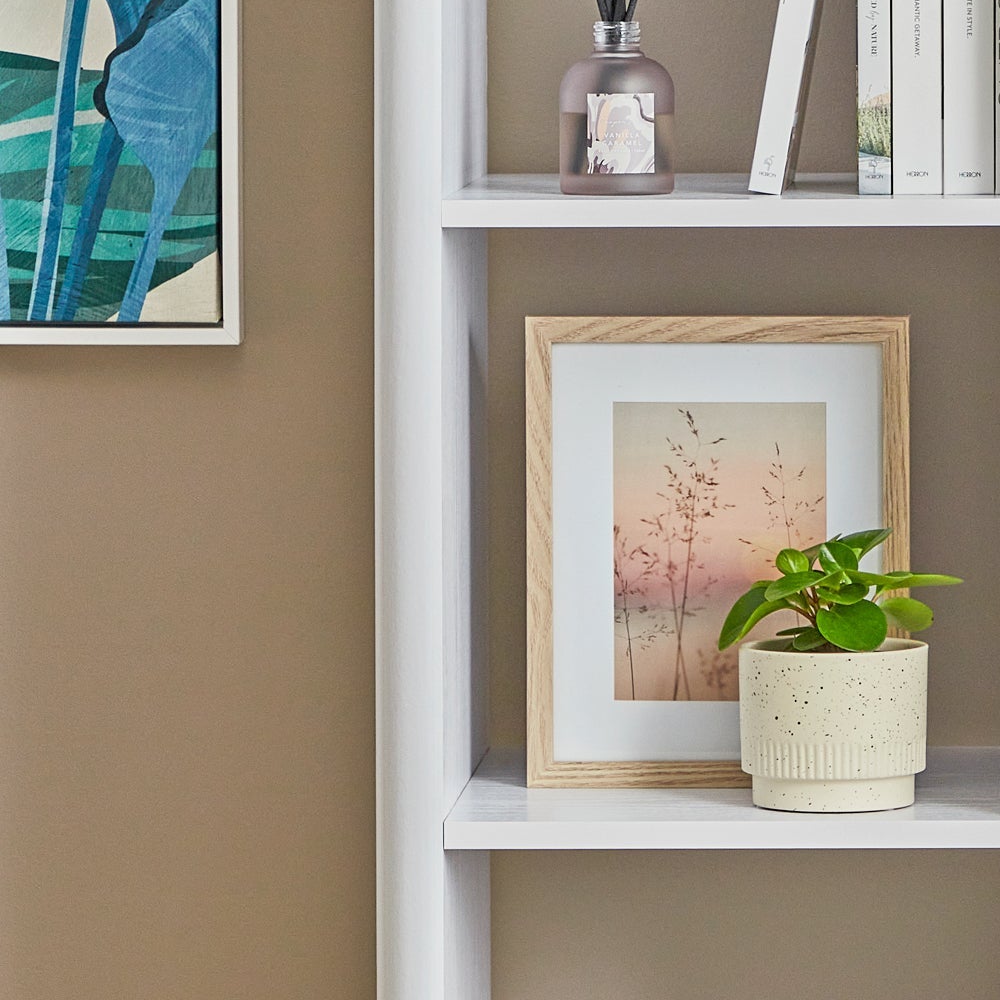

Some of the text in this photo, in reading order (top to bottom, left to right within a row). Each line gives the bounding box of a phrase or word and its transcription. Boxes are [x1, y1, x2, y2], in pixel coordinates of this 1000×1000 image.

[864, 9, 881, 21] by
[966, 7, 973, 15] IN
[870, 24, 878, 56] NATURE
